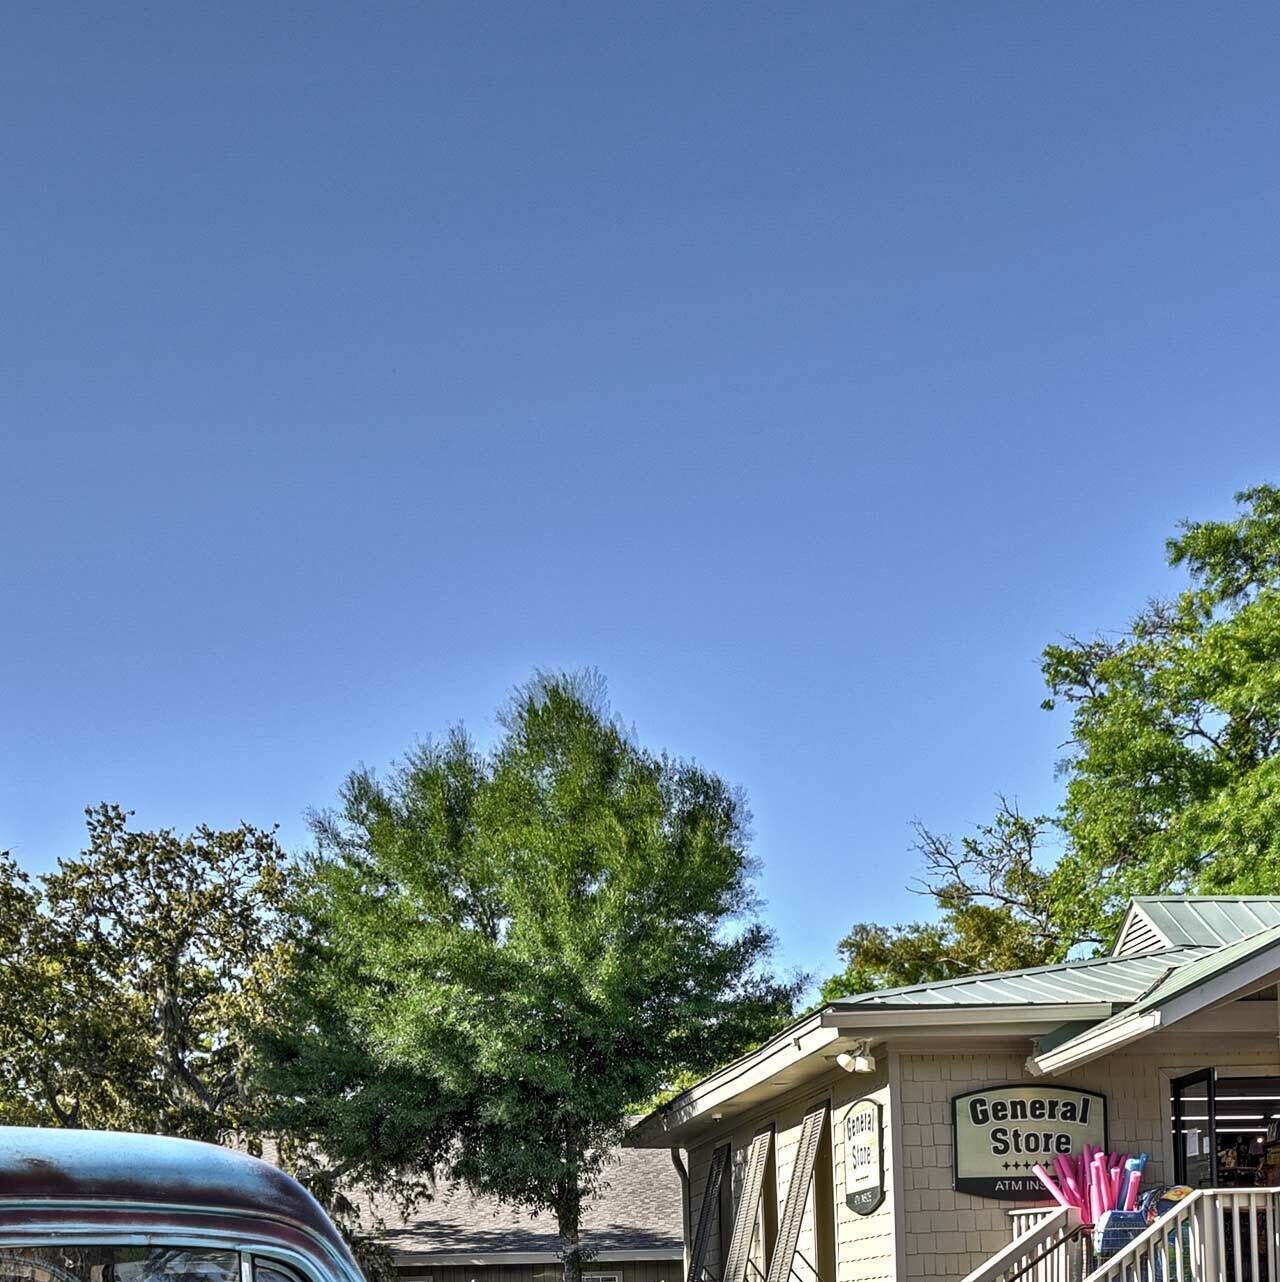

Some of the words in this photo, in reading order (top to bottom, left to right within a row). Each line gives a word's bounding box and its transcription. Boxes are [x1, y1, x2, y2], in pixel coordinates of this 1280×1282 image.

[847, 1108, 875, 1141] General
[969, 1097, 1091, 1126] General
[991, 1127, 1072, 1156] Store
[852, 1145, 871, 1170] Store
[995, 1180, 1022, 1191] ATM
